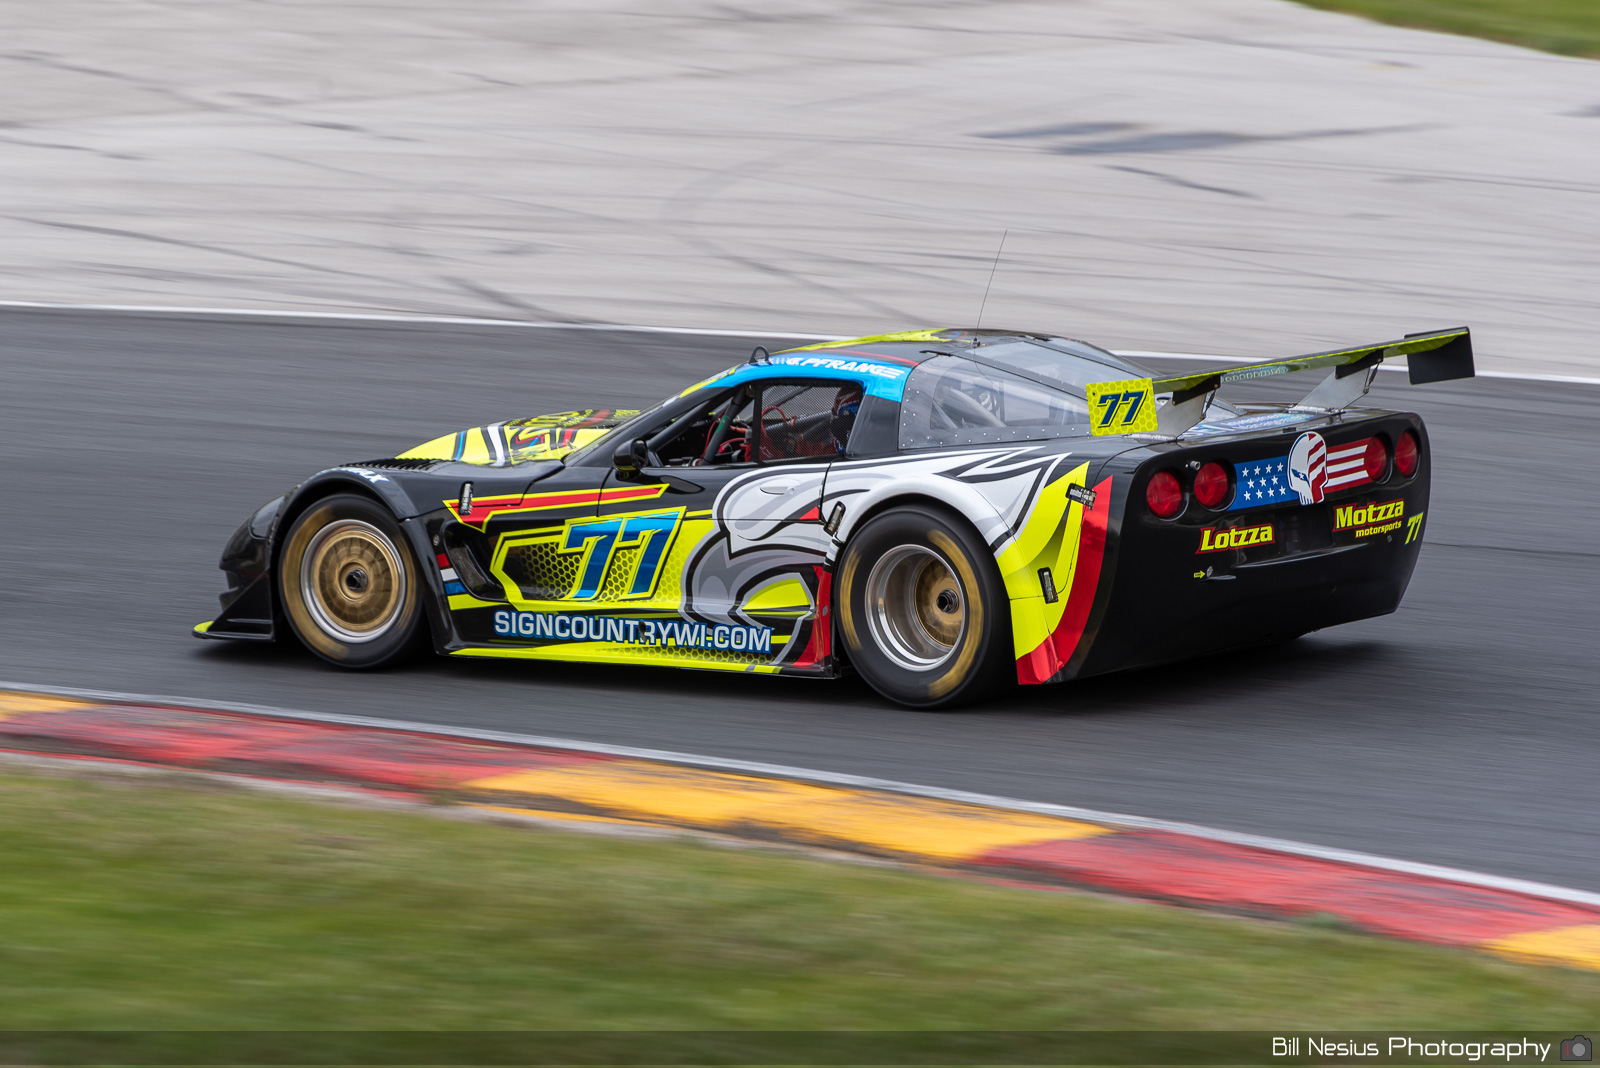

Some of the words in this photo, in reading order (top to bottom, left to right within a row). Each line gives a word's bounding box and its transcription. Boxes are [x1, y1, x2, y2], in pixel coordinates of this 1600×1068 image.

[1097, 389, 1148, 428] 77
[1335, 500, 1404, 529] Motzza
[1355, 520, 1402, 538] motorsports
[1404, 511, 1424, 546] 77
[560, 508, 684, 600] 77
[1199, 525, 1273, 551] Lotzza
[494, 610, 771, 652] SIGNCOUNTRYWI.COM
